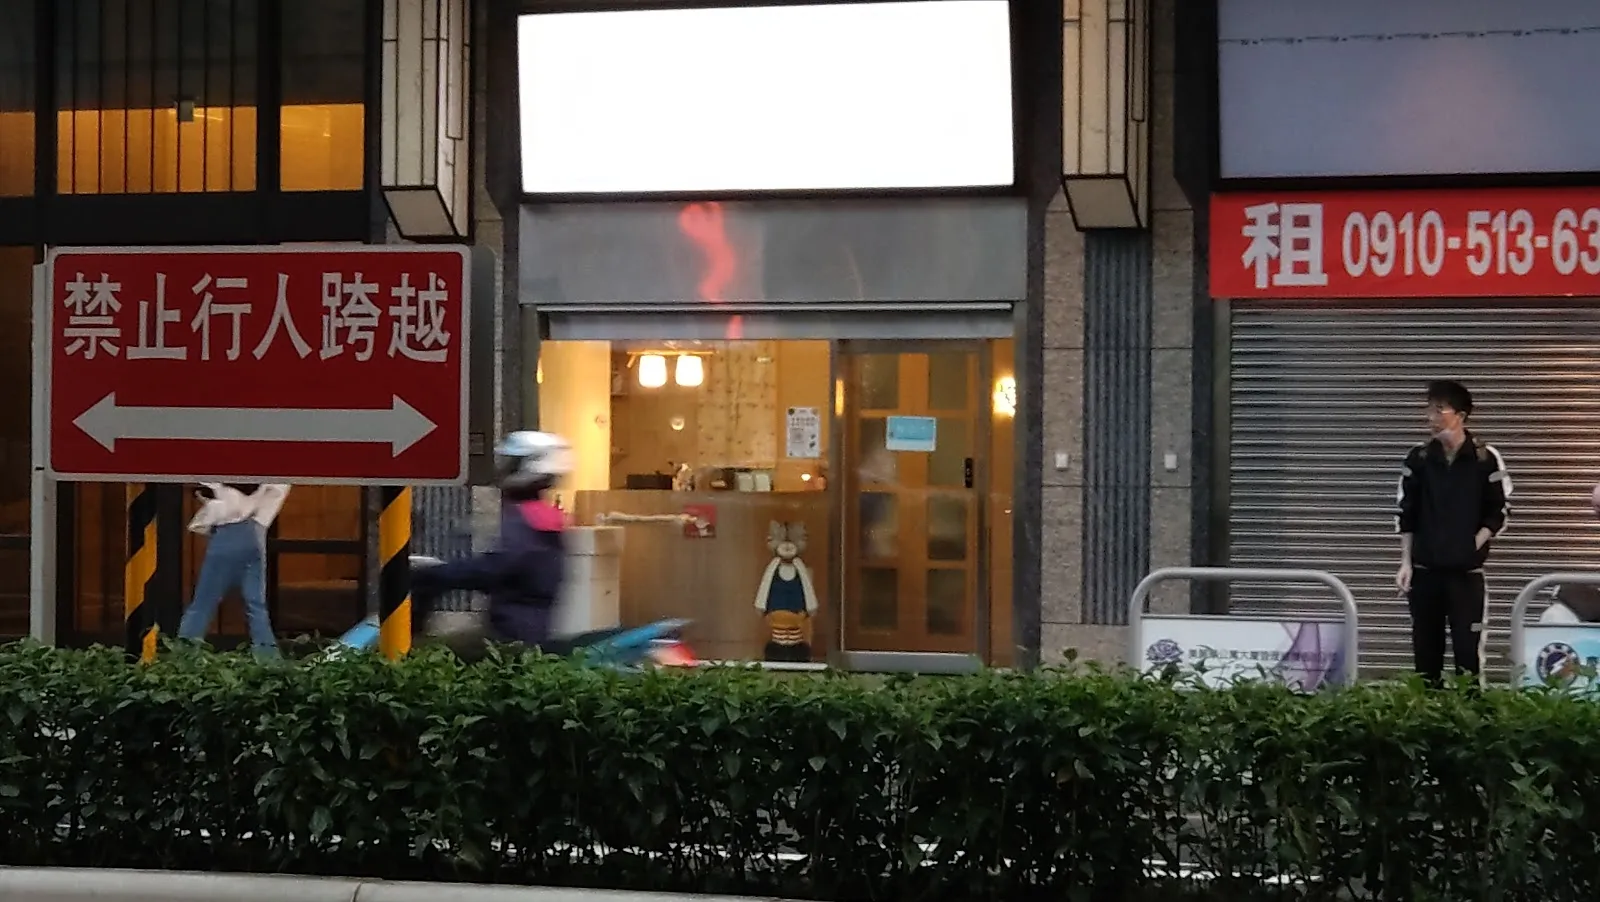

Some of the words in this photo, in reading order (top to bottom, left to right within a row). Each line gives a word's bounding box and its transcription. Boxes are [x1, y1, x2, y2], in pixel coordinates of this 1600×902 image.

[1241, 202, 1329, 289] 租
[1342, 207, 1600, 277] 0910-513-63
[63, 272, 451, 362] 禁止行人跨越
